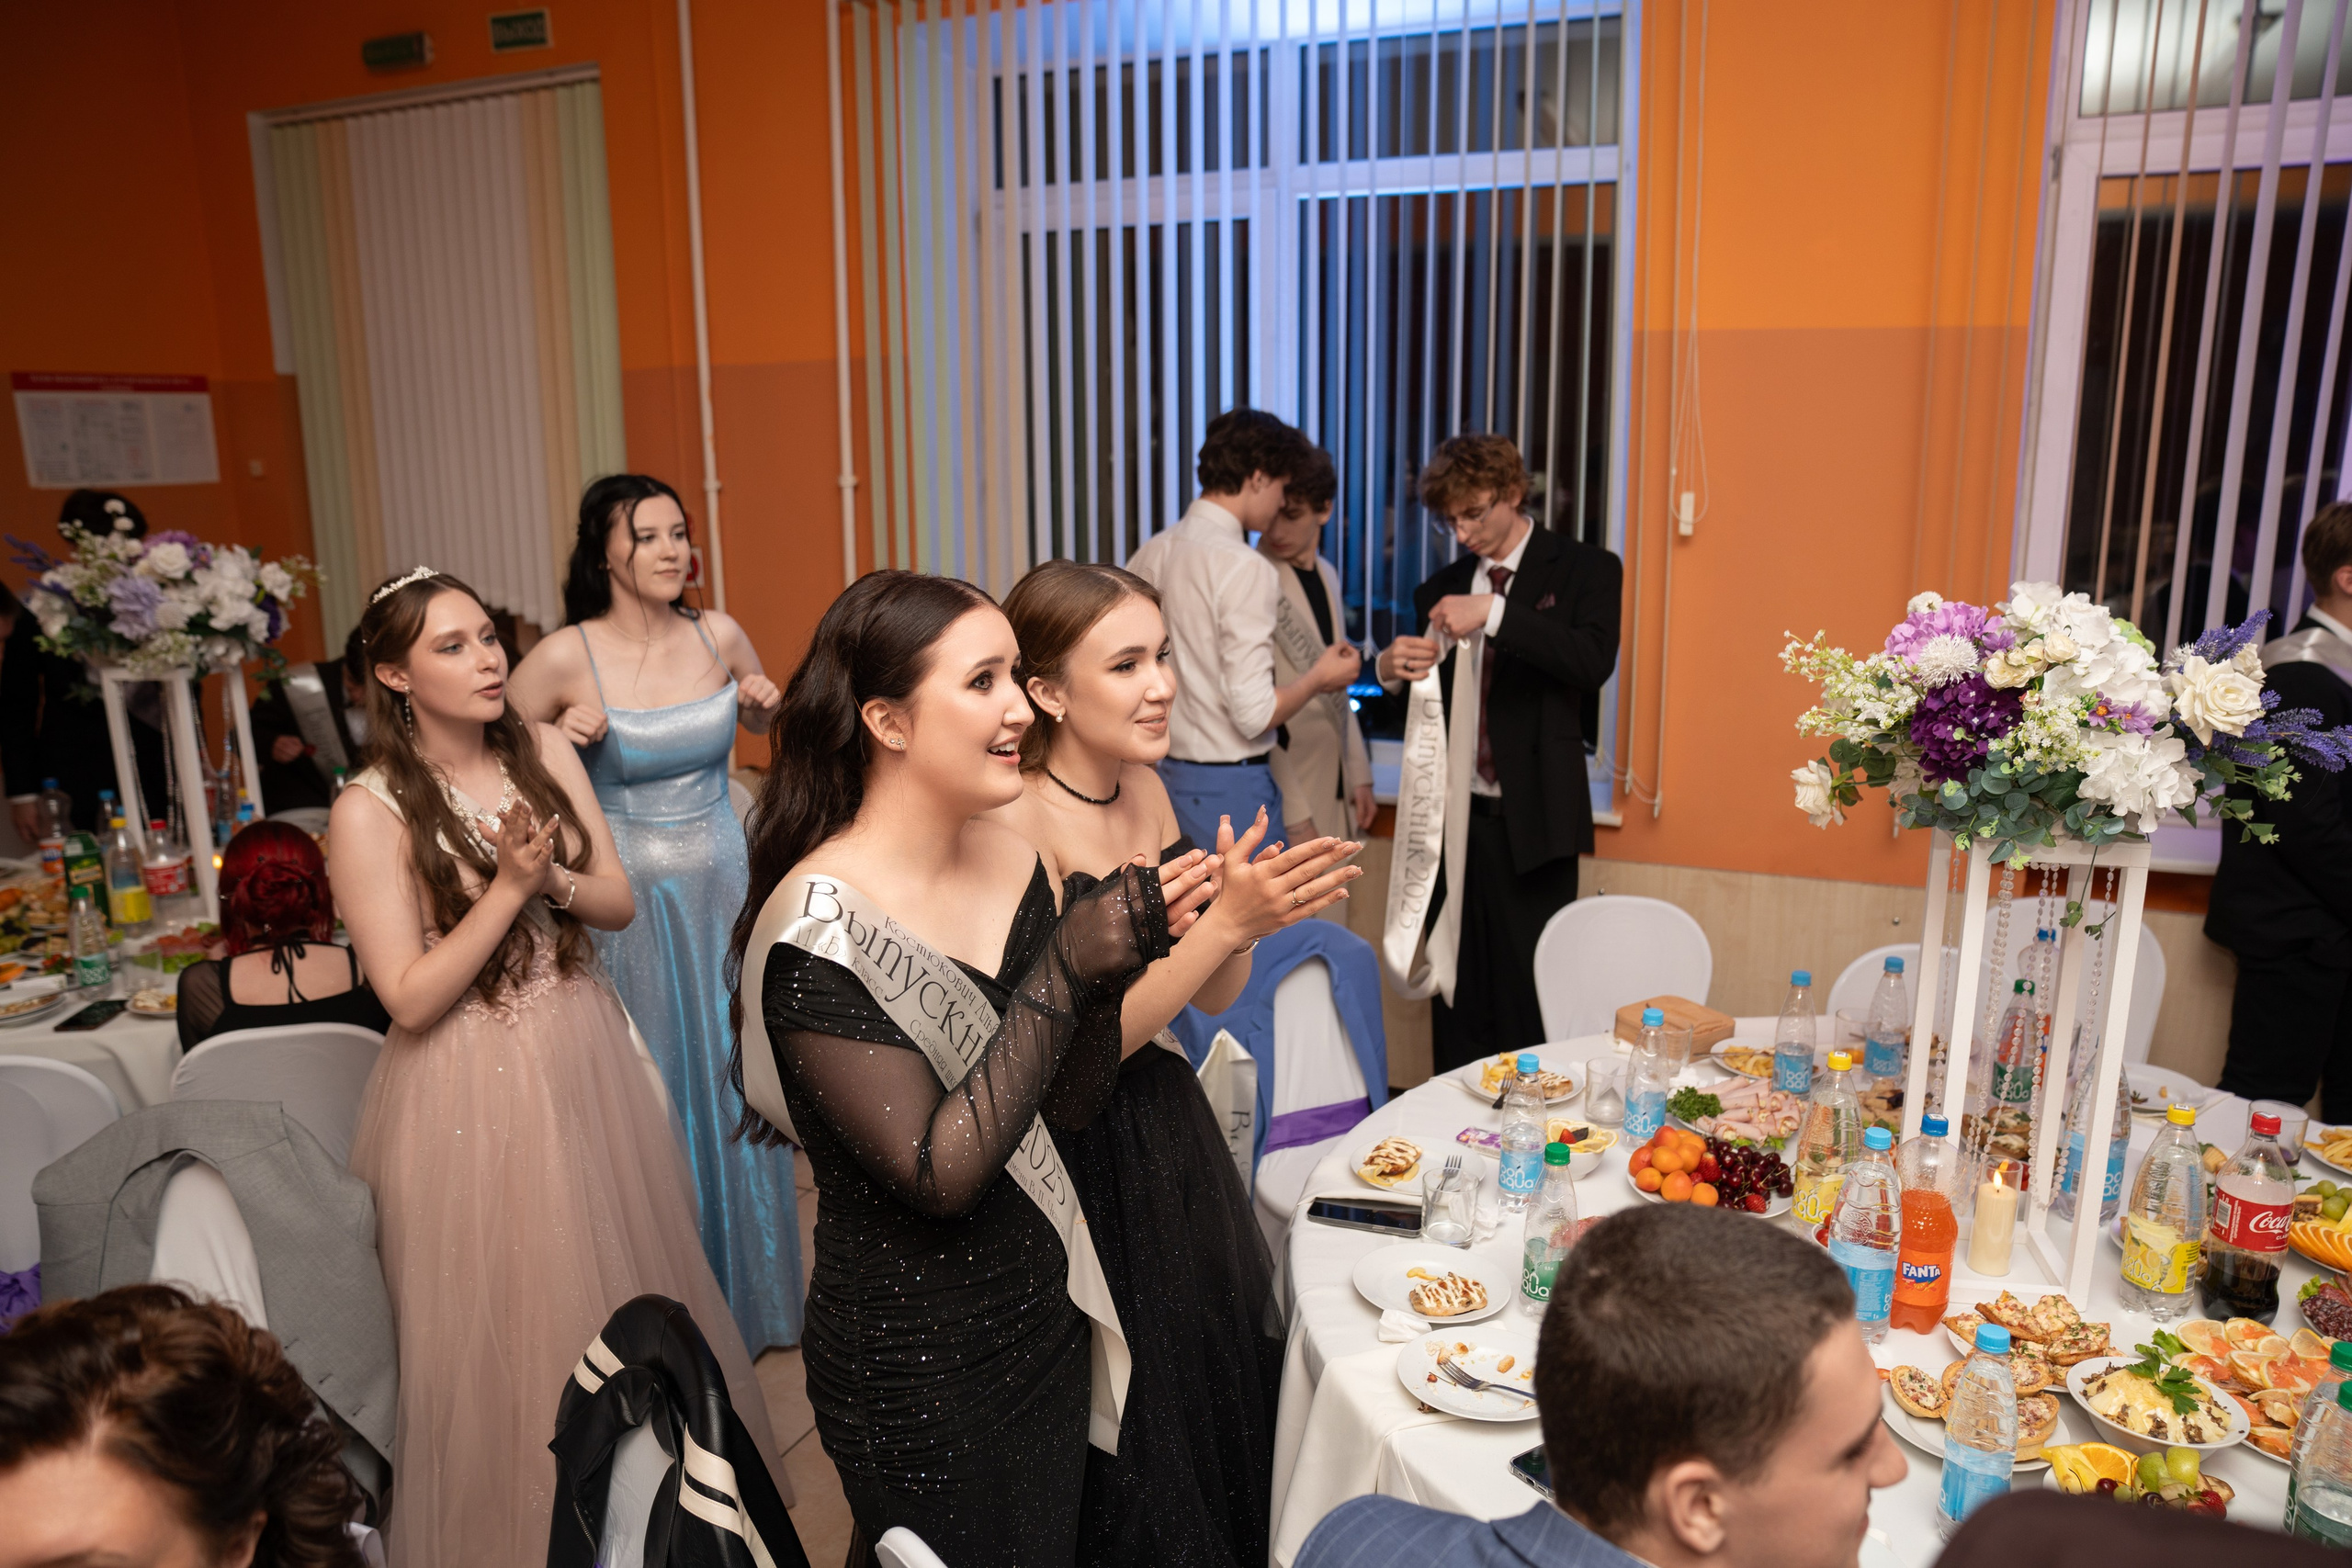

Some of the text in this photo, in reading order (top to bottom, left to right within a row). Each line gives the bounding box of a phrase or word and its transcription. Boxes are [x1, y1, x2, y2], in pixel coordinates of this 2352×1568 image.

[1398, 866, 1430, 930] 2025
[797, 881, 985, 1067] Выпускн
[884, 916, 1001, 1037] Костюкович Альб
[793, 925, 813, 947] 11
[817, 935, 847, 958] «Б»
[851, 956, 884, 999] класс
[910, 1019, 947, 1073] Средняя
[944, 1067, 959, 1088] шко
[1785, 1079, 1810, 1090] aqu
[1499, 1172, 1534, 1190] aqua
[1523, 1269, 1540, 1285] on
[1902, 1260, 1941, 1279] FANTA
[1522, 1278, 1550, 1297] qua
